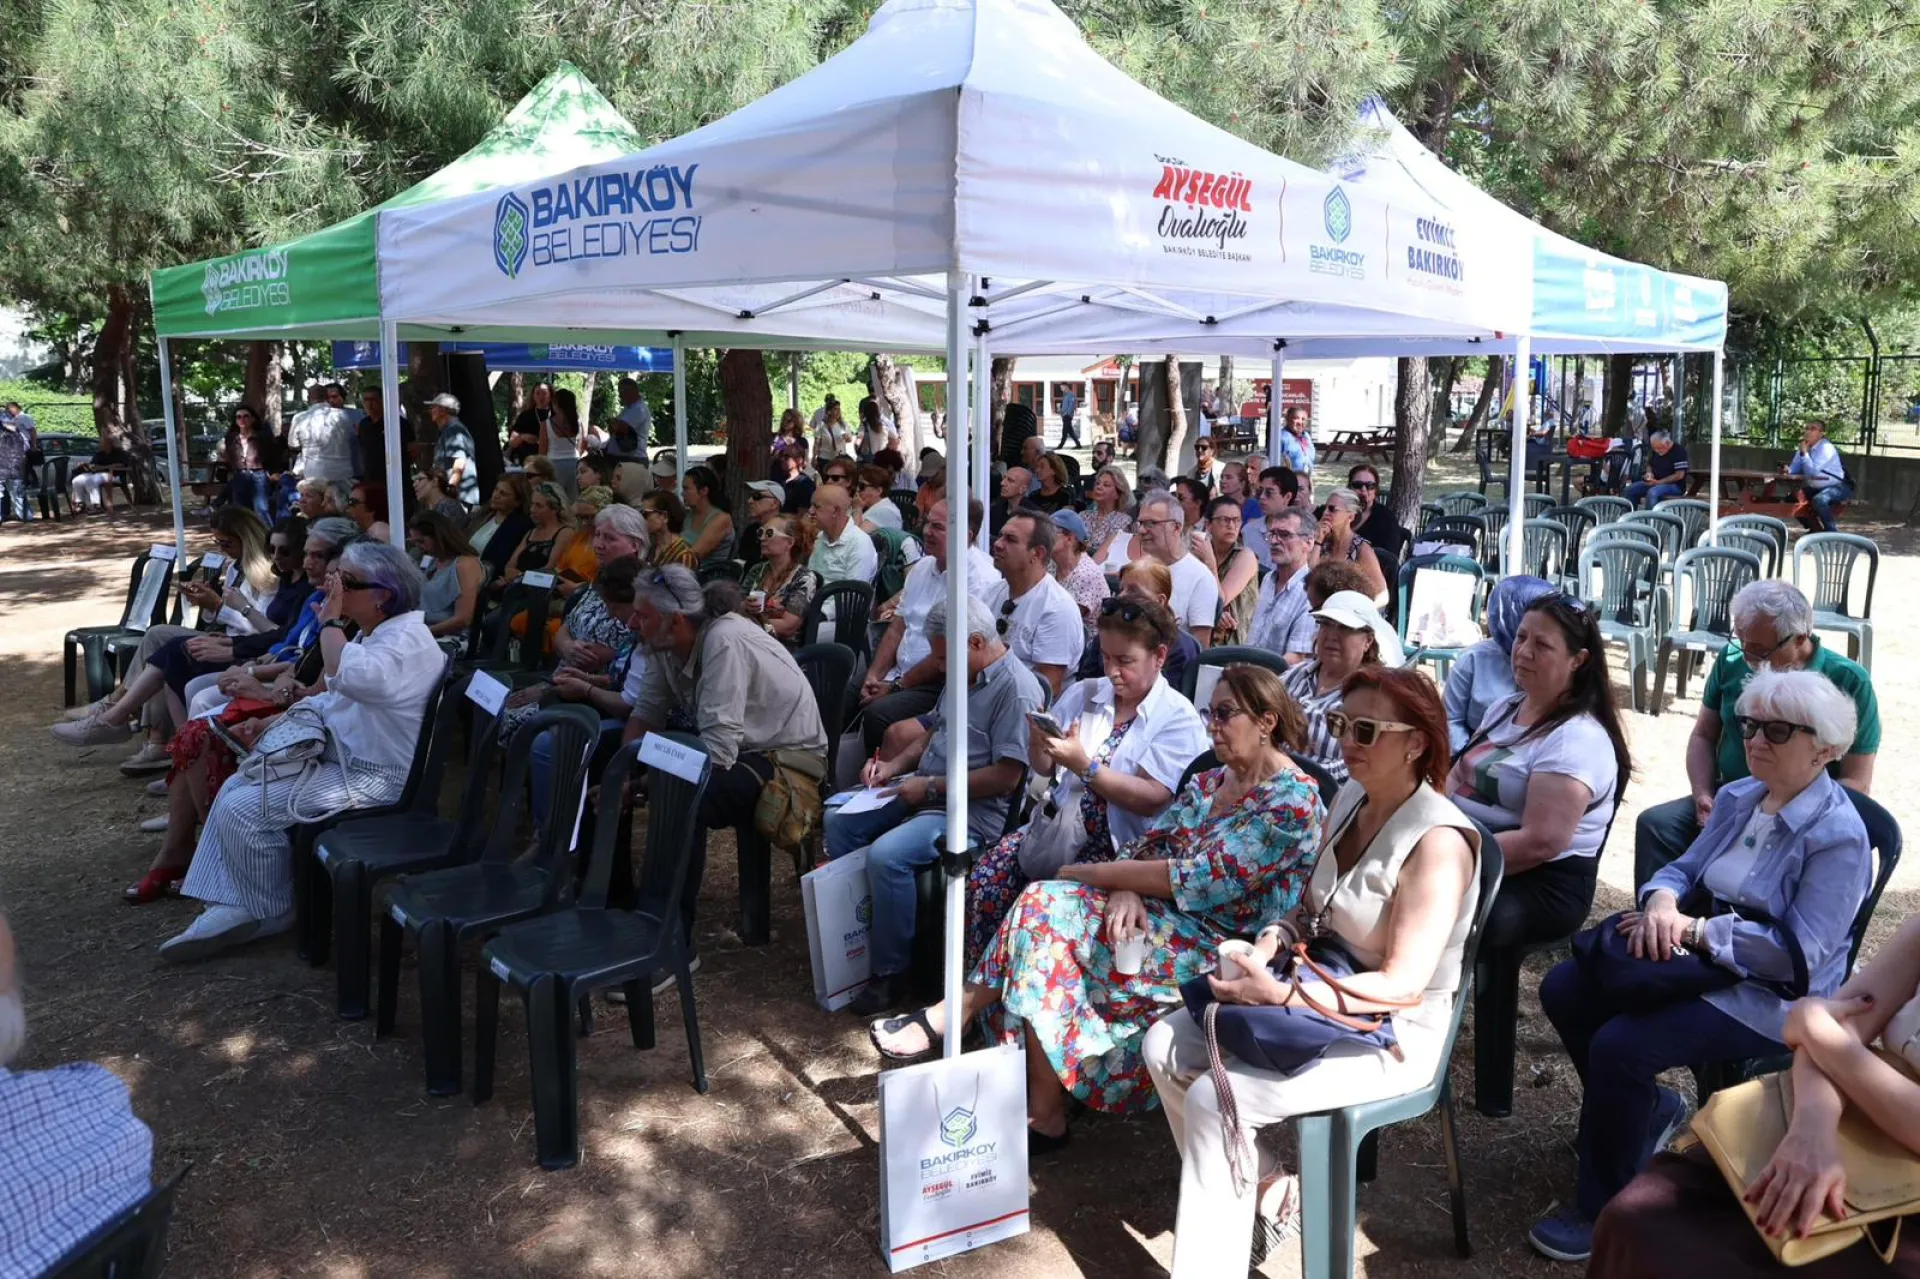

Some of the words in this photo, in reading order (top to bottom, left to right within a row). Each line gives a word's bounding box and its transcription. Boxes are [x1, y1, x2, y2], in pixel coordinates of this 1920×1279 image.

[531, 163, 699, 229] BAKIRKÖY
[1152, 165, 1252, 212] AYŞEGÜL
[533, 215, 702, 266] BELEDİYESİ
[1157, 205, 1247, 250] Ovalıoğlu
[1408, 245, 1464, 282] BAKIRKÖY
